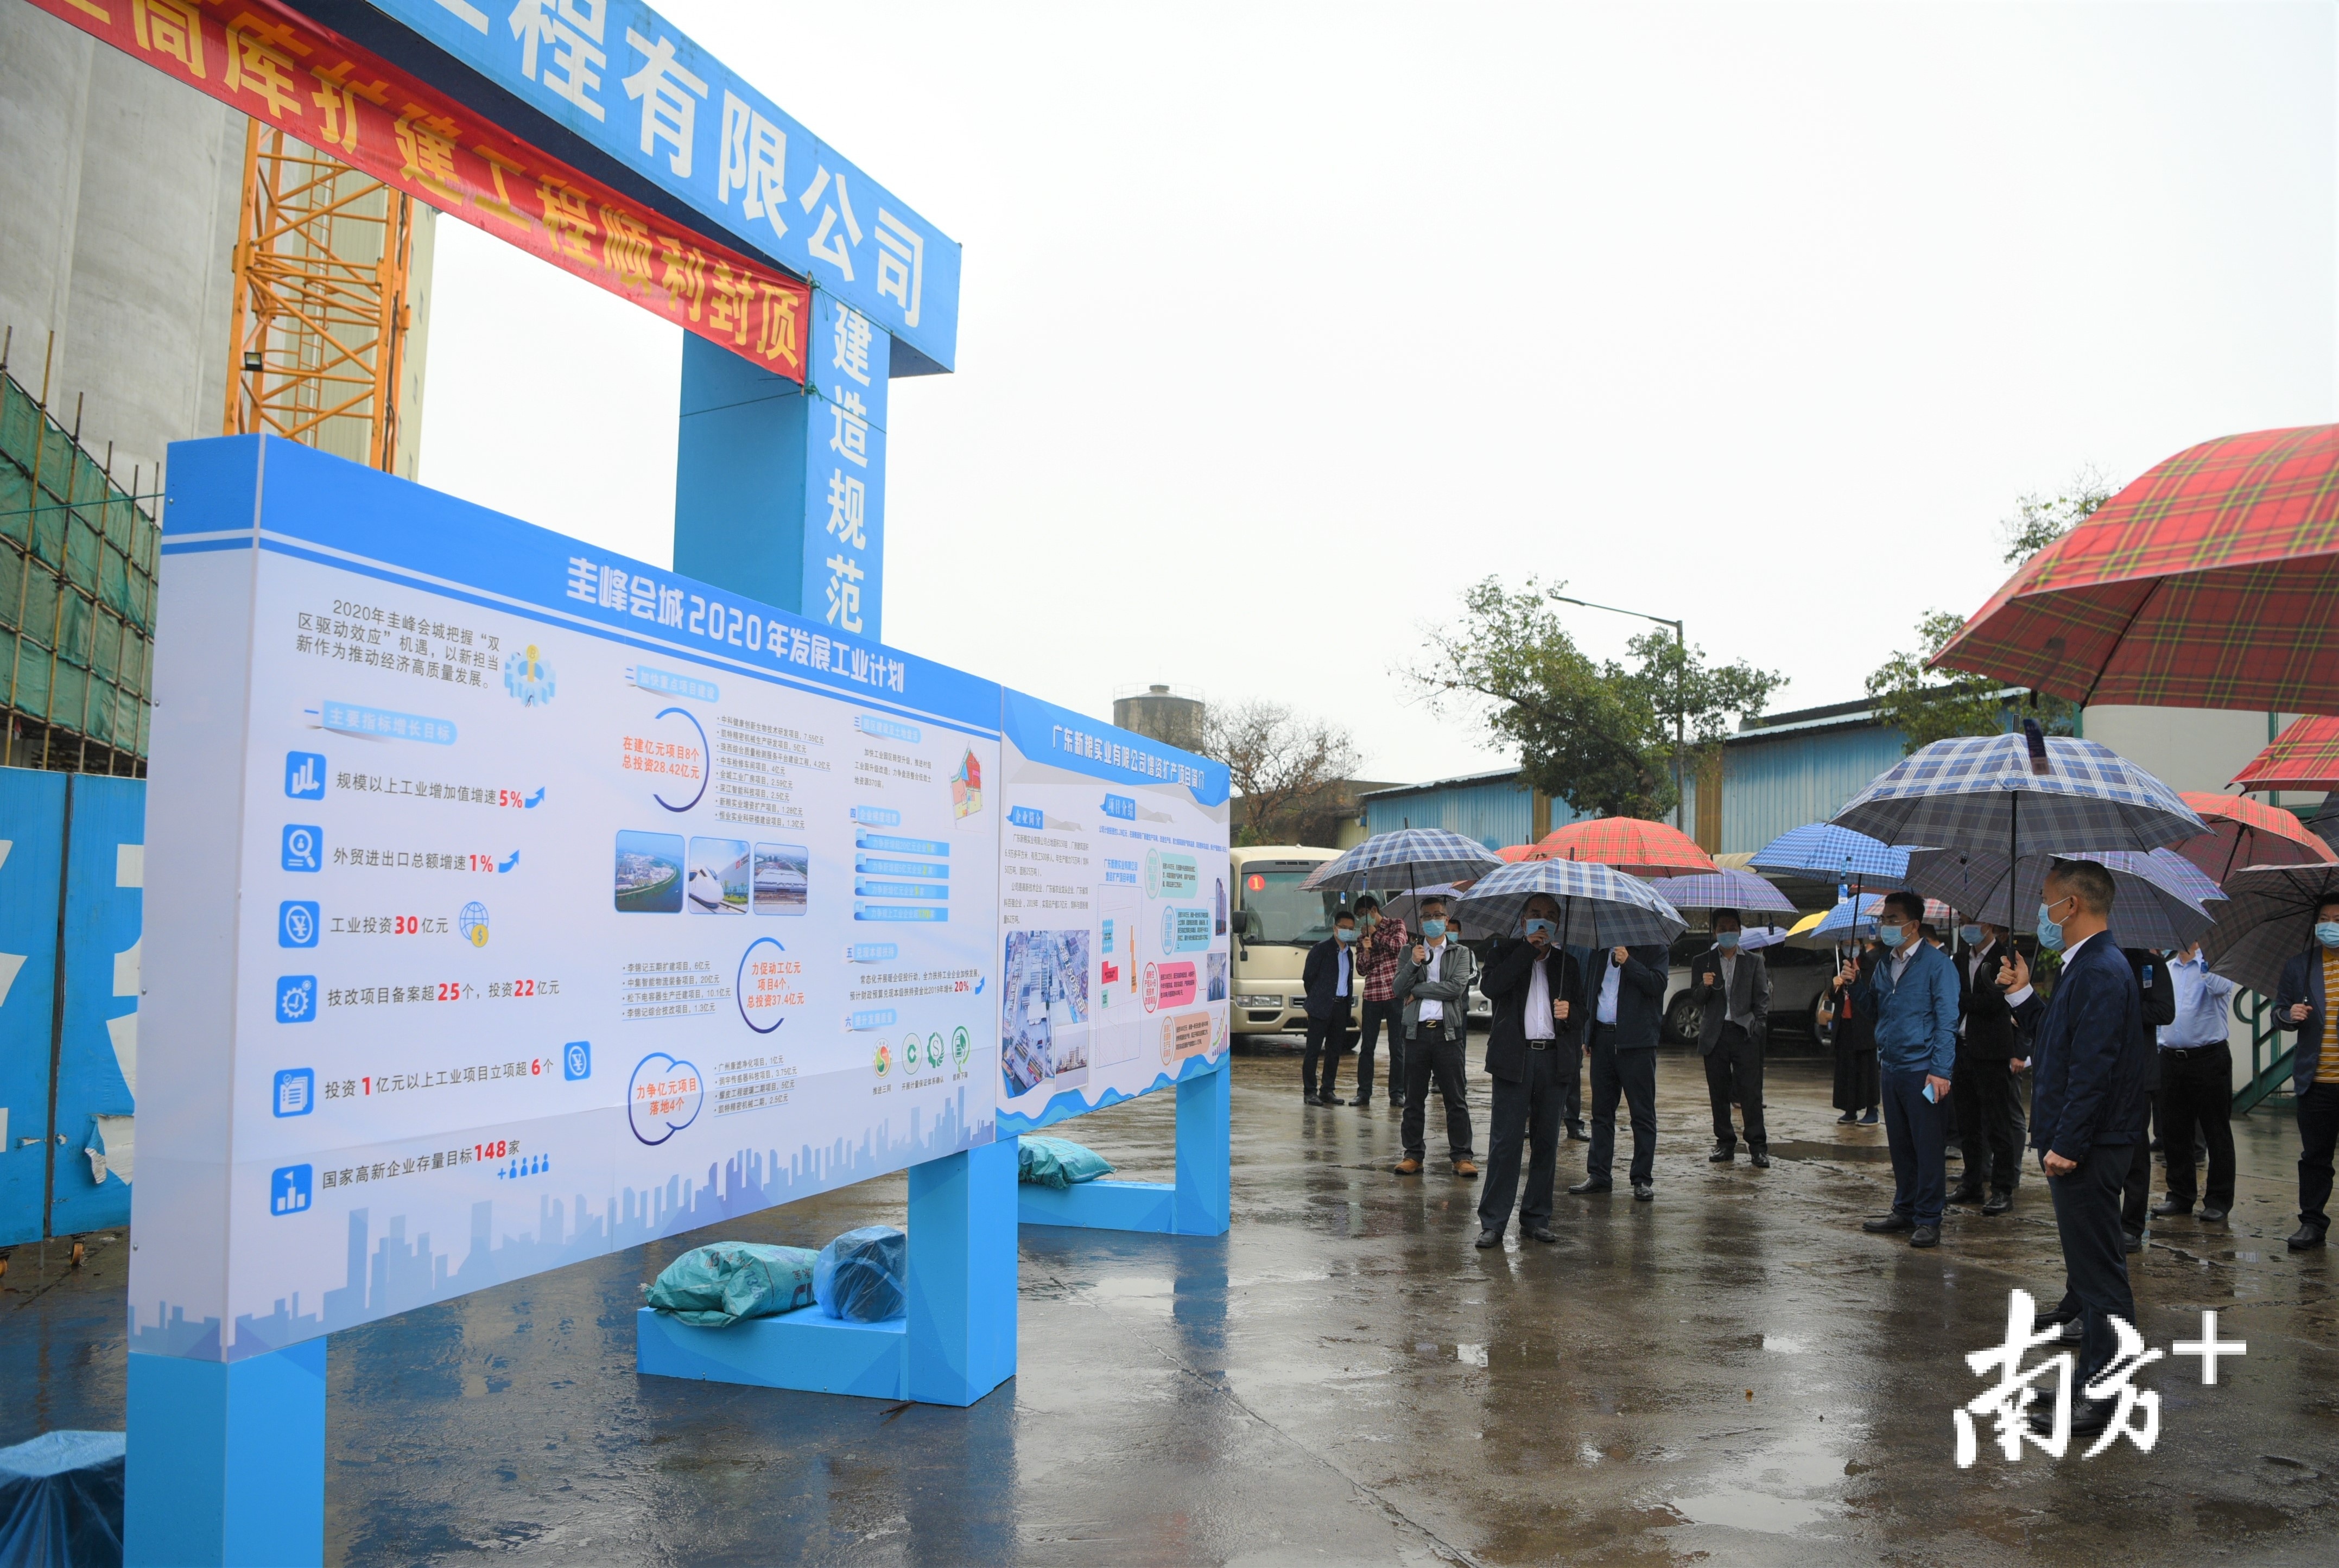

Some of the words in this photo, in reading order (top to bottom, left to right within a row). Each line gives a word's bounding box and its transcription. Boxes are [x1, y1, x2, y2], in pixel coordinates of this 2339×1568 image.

[437, 0, 923, 328] 程有限公司
[826, 301, 872, 634] 建造规范
[567, 557, 904, 693] 圭峰会城2020年发展工业计划
[329, 707, 450, 741] 主要指标增长目标
[623, 735, 700, 759] 在建亿元项目8个
[622, 754, 700, 779] 总投资28.42亿元
[1016, 809, 1041, 827] 企业简介
[333, 847, 493, 873] 外贸进出口总额增速1%
[1253, 877, 1260, 890] 1
[331, 915, 449, 935] 工业投资30亿元
[752, 961, 801, 976] 力促动工亿元
[746, 992, 805, 1008] 总投资37.4亿元
[637, 1077, 697, 1100] 力争亿元项目
[649, 1097, 685, 1116] 落地4个
[322, 1139, 521, 1190] 国家高新企业存量目标148家
